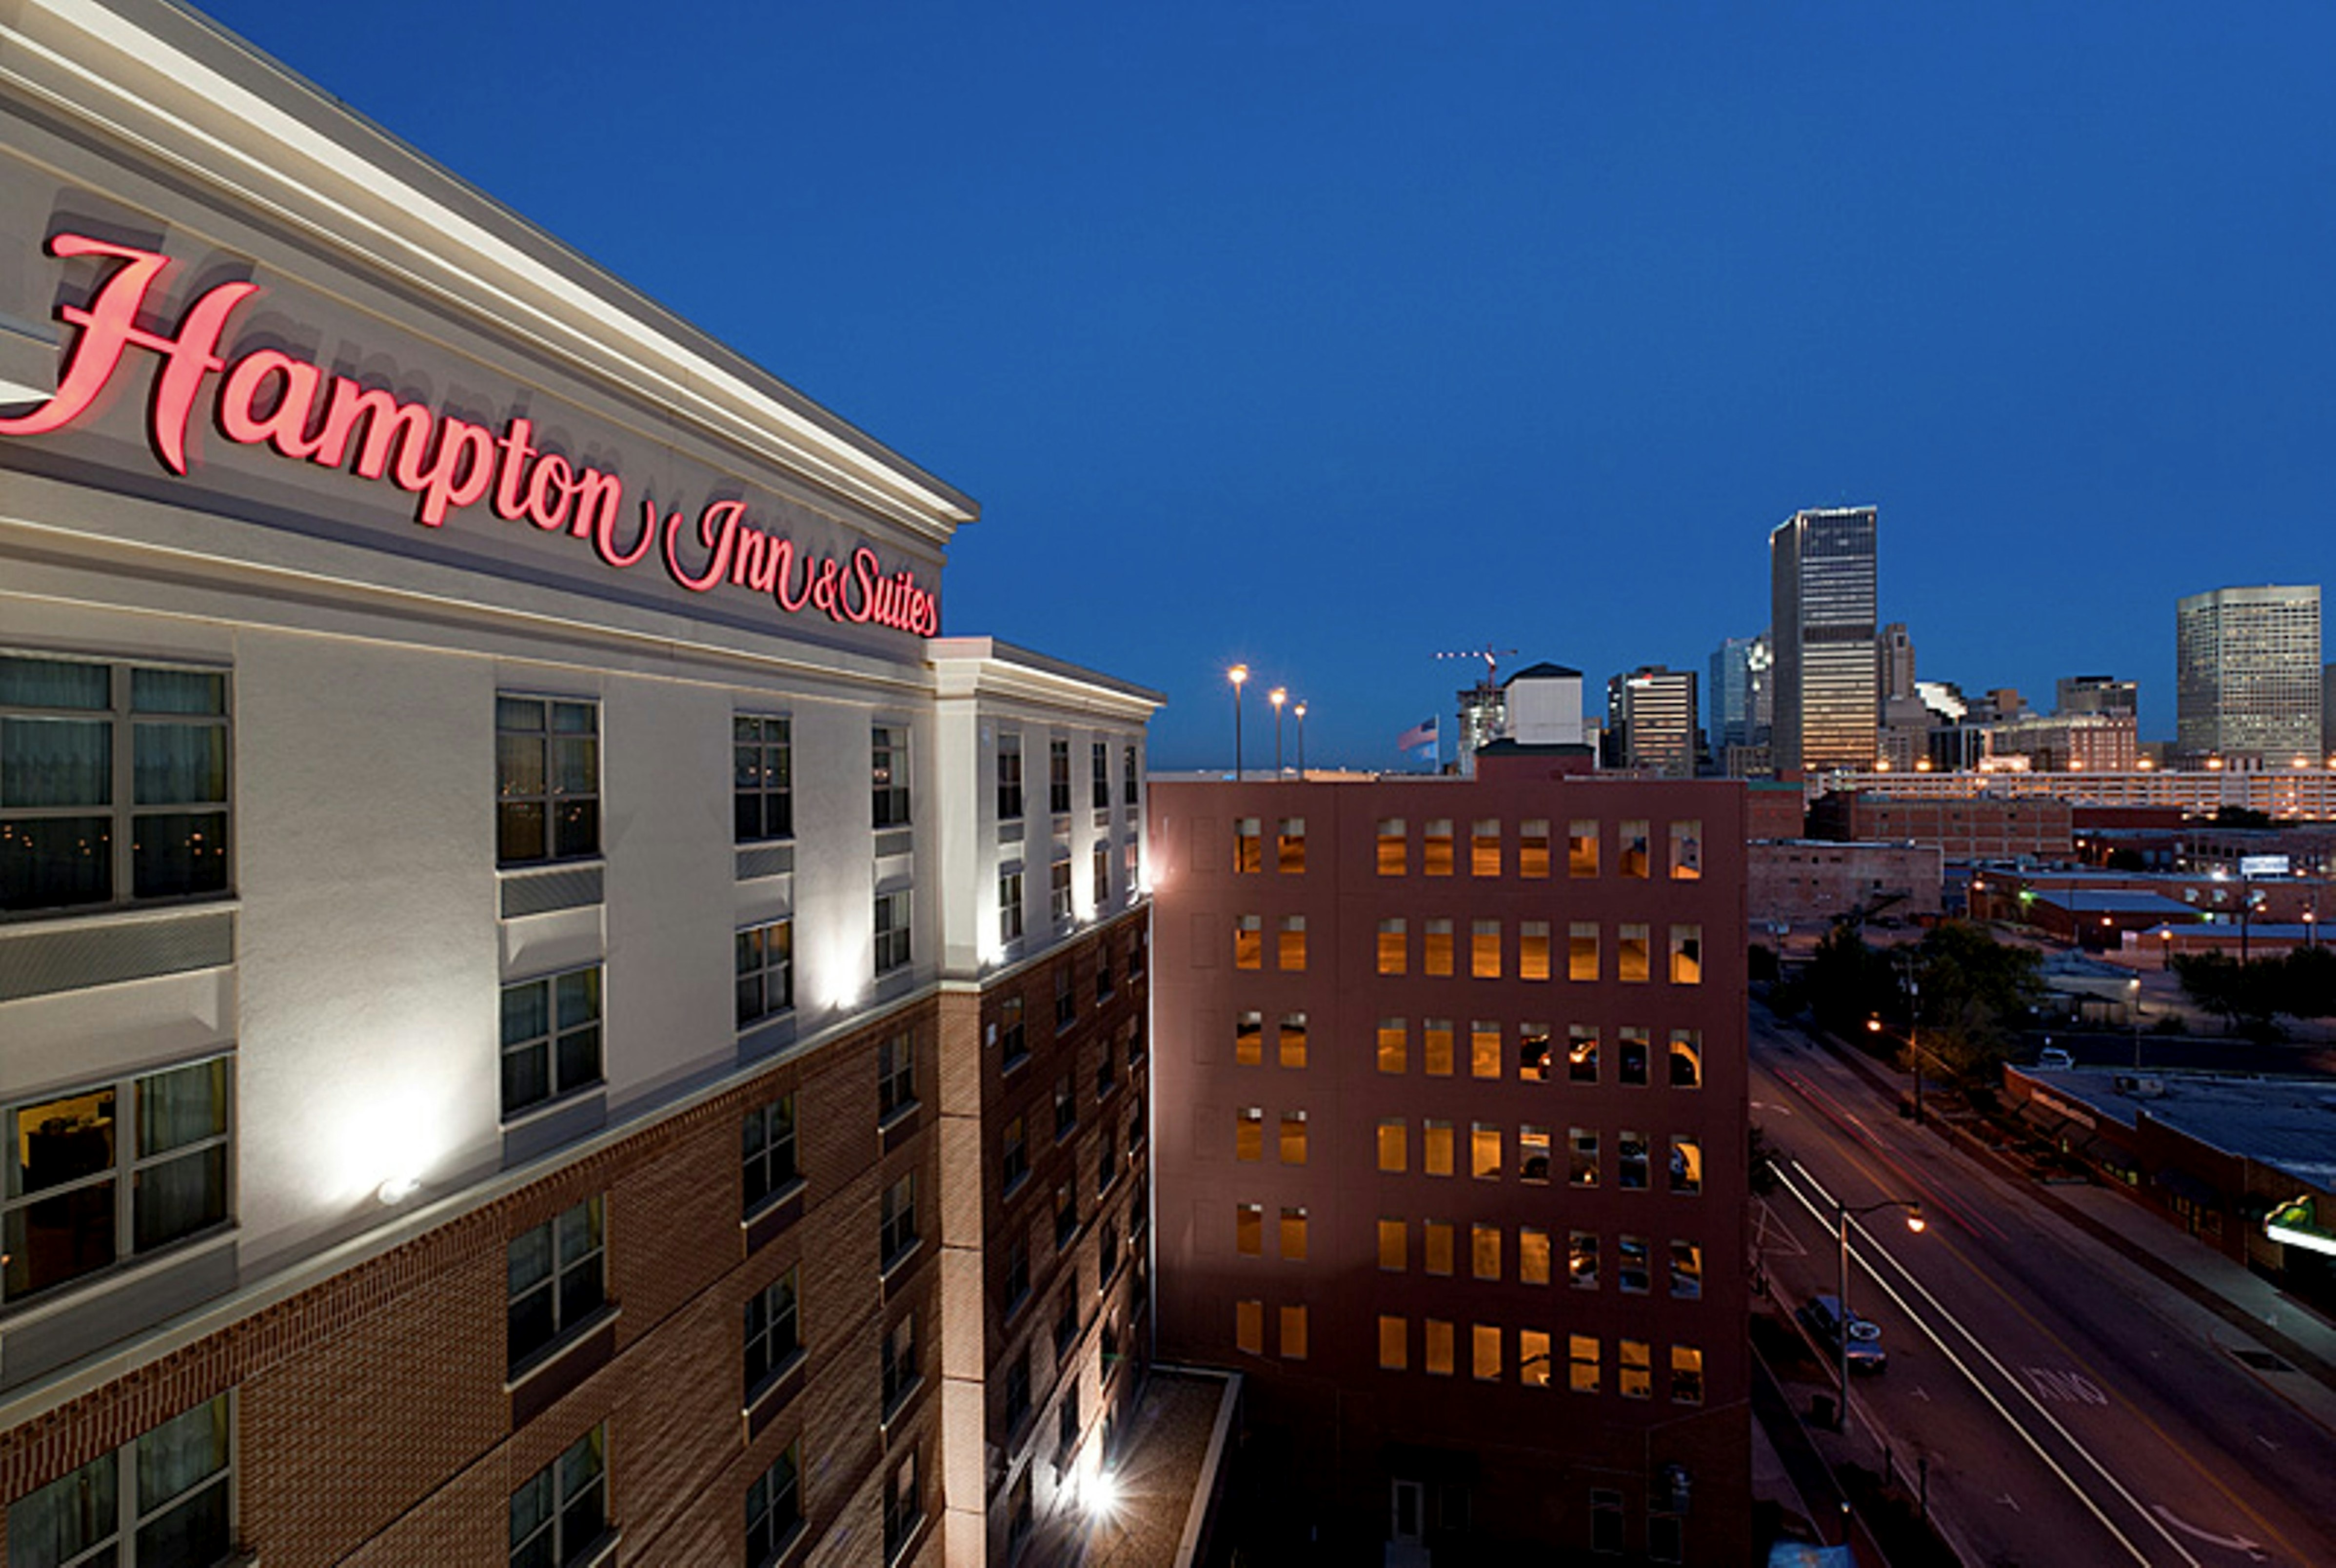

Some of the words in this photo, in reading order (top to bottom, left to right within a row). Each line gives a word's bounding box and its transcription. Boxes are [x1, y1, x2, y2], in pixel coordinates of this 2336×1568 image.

[0, 234, 657, 567] Hampton
[666, 500, 814, 612] Inn
[813, 558, 844, 622] &
[840, 547, 937, 637] Suites
